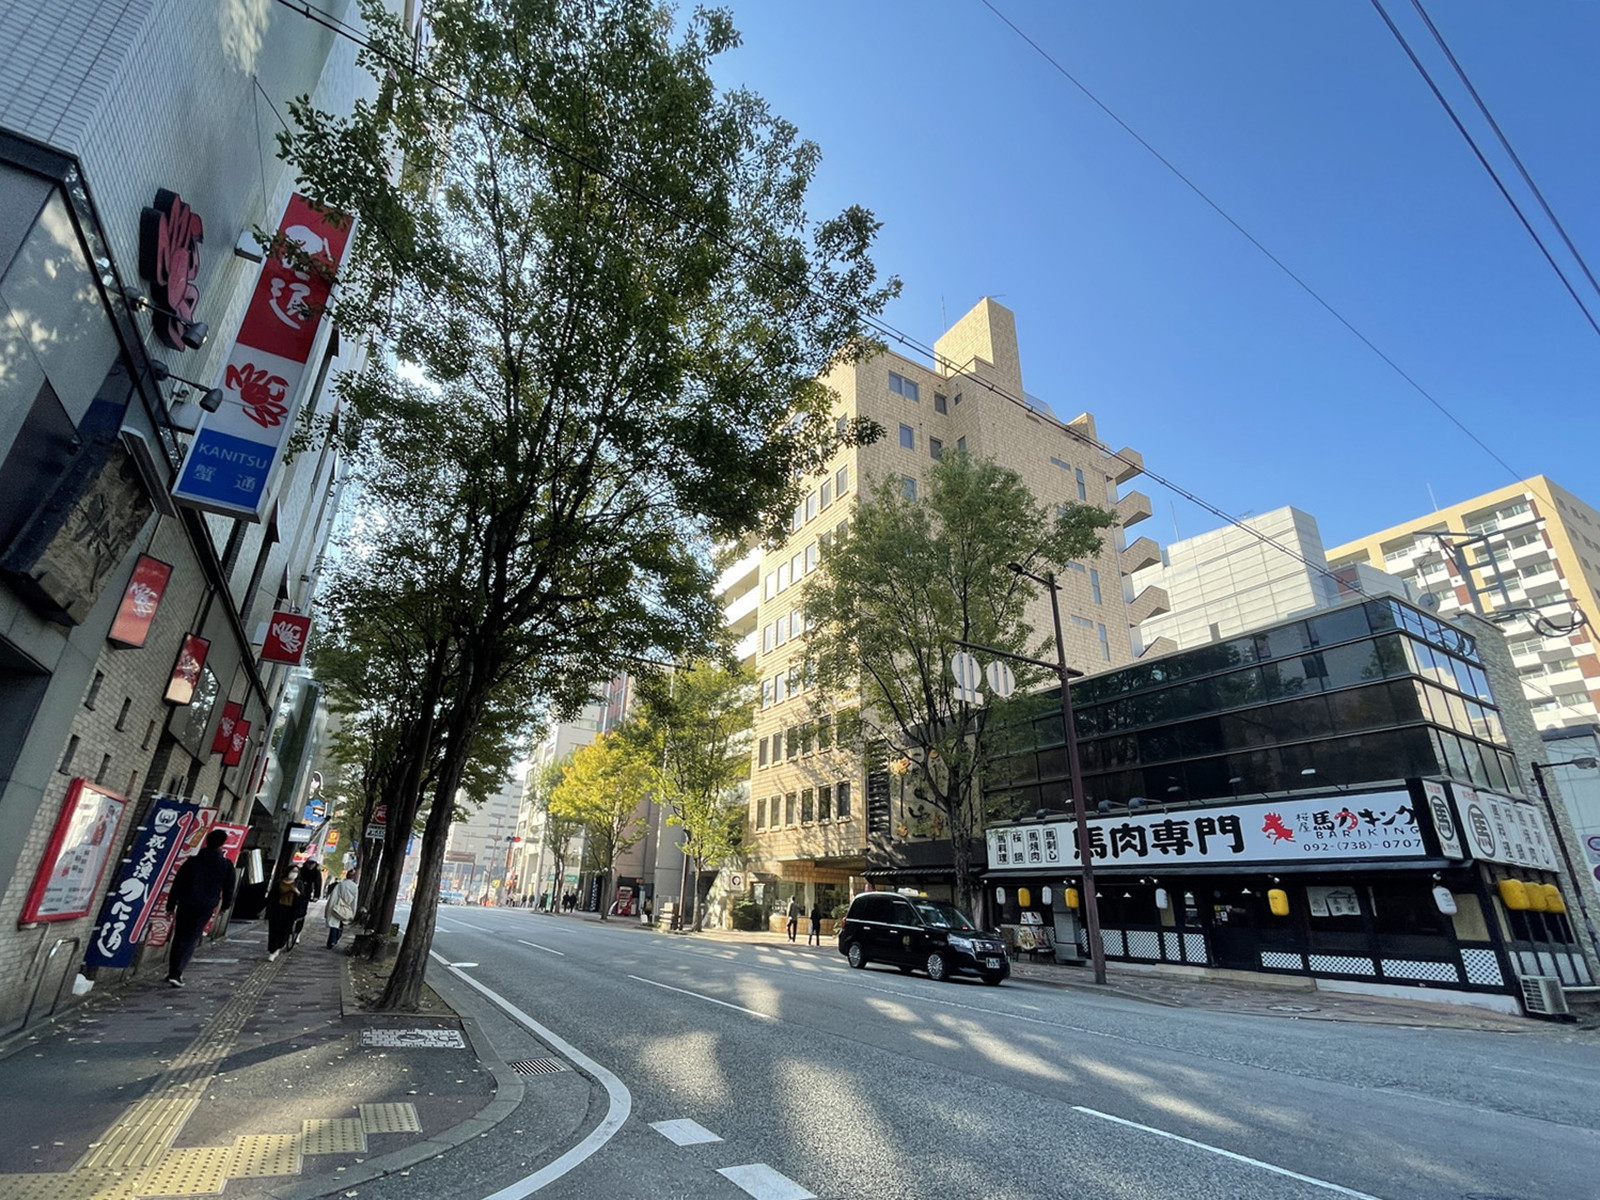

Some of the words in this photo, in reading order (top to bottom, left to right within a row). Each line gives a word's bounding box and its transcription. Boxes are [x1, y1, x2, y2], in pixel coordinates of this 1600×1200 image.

[198, 443, 268, 469] KANITSU
[1296, 812, 1312, 833] 桜屋
[1433, 802, 1451, 833] 馬
[1470, 812, 1493, 849] 馬
[1045, 831, 1057, 860] 馬刺し
[1072, 814, 1245, 860] 馬肉専門
[1303, 839, 1422, 852] 092-(738)-0707
[1315, 826, 1420, 839] BARIKING
[133, 834, 167, 880] 祝大漁
